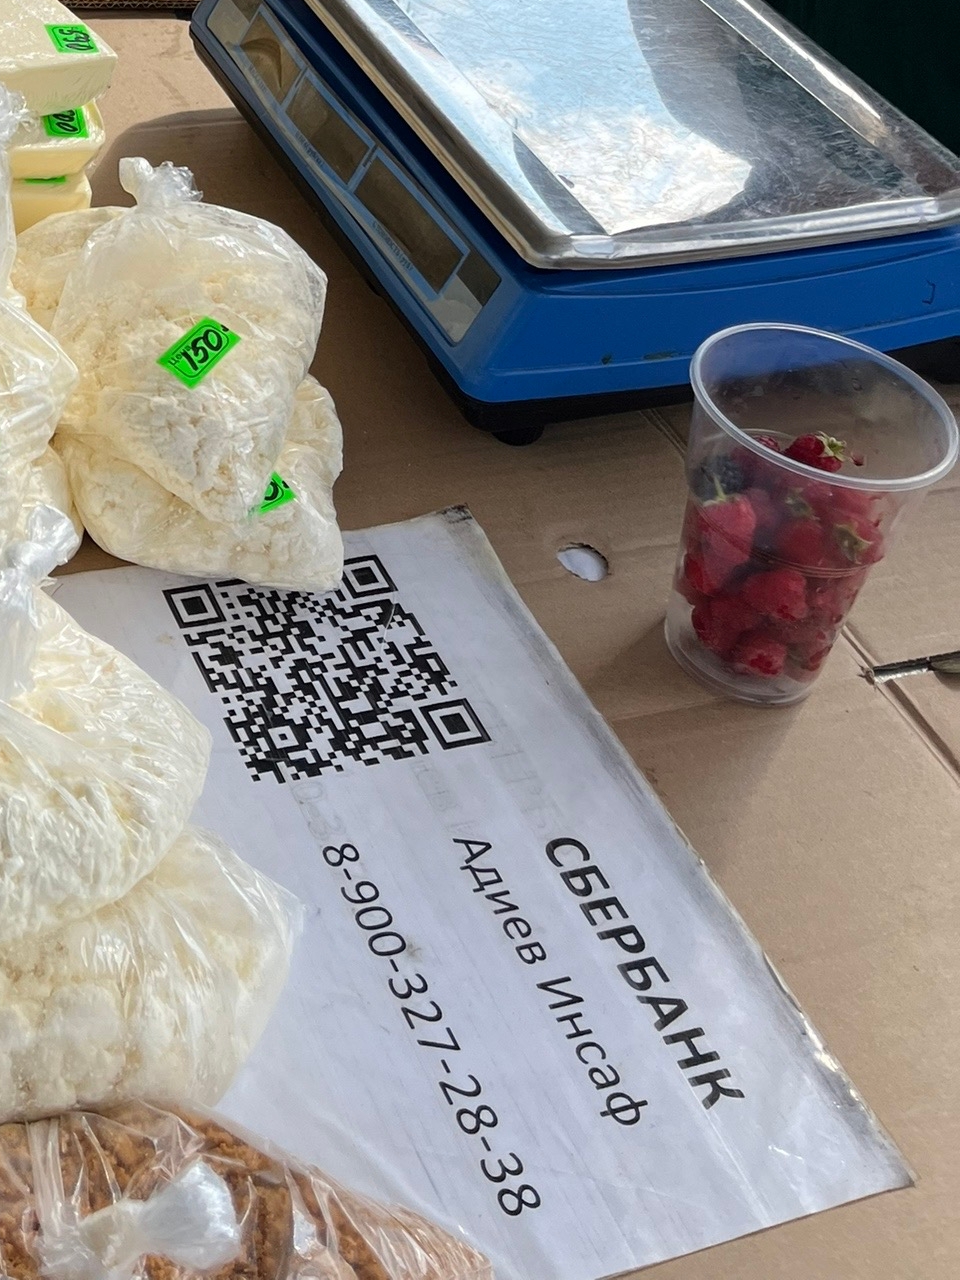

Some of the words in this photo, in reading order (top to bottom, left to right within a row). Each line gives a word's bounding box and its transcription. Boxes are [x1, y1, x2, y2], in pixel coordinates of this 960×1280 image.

[180, 329, 223, 372] 150
[322, 842, 541, 1217] 8-900-327-28-38
[452, 837, 547, 966] Адиев
[536, 975, 649, 1127] Инсаф
[545, 837, 746, 1110] СБЕРБАНК
